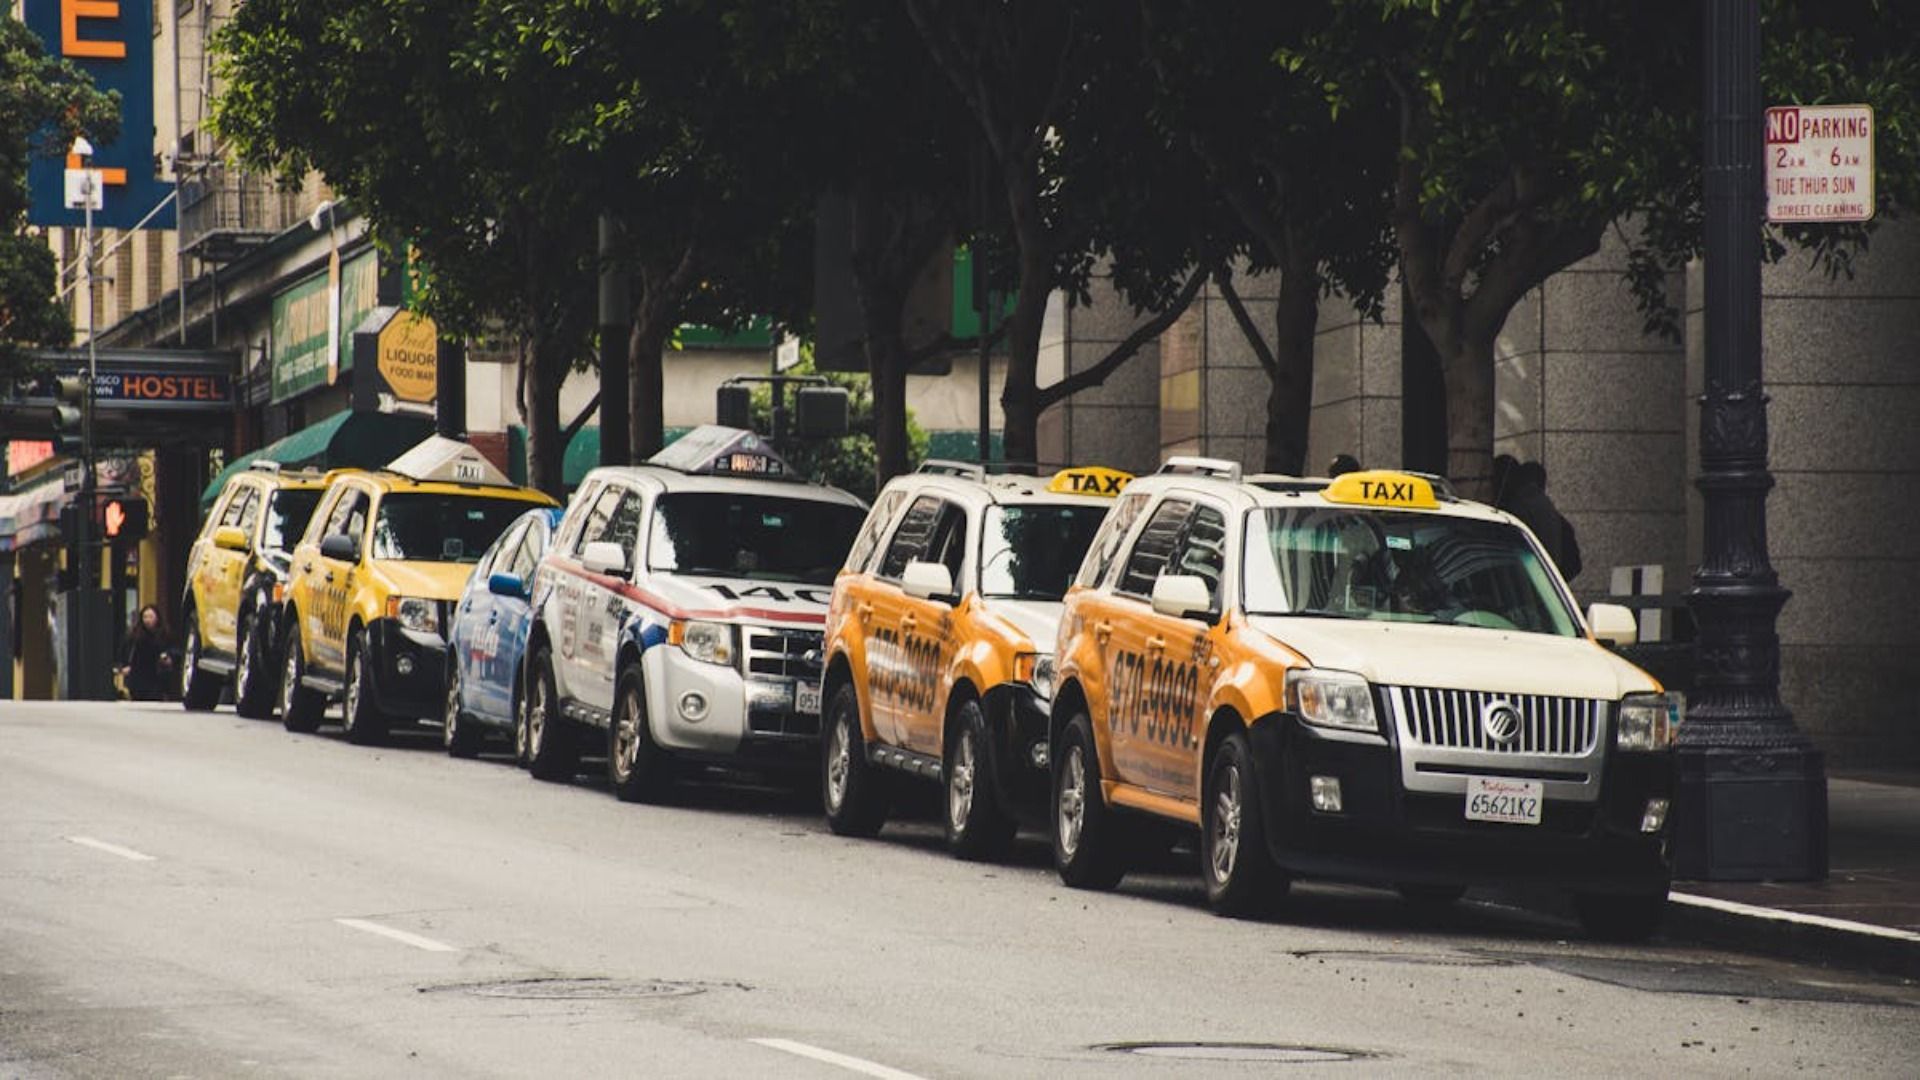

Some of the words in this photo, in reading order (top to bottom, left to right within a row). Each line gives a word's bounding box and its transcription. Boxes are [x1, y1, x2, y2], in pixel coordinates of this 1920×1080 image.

[1769, 111, 1798, 141] NO
[1802, 116, 1868, 139] PARKING
[1776, 147, 1788, 168] 2
[1830, 146, 1841, 166] 6
[1776, 177, 1796, 195] TUE
[1799, 176, 1829, 194] THUR
[1832, 175, 1856, 194] SUN
[1777, 203, 1811, 216] STREET
[1813, 201, 1864, 216] CLEANING
[415, 370, 435, 381] MAR
[123, 373, 224, 399] HOSTEL
[457, 464, 480, 481] TAXI
[1067, 473, 1132, 494] TAX
[1360, 481, 1414, 501] TAXI
[1471, 793, 1537, 817] 65621K2
